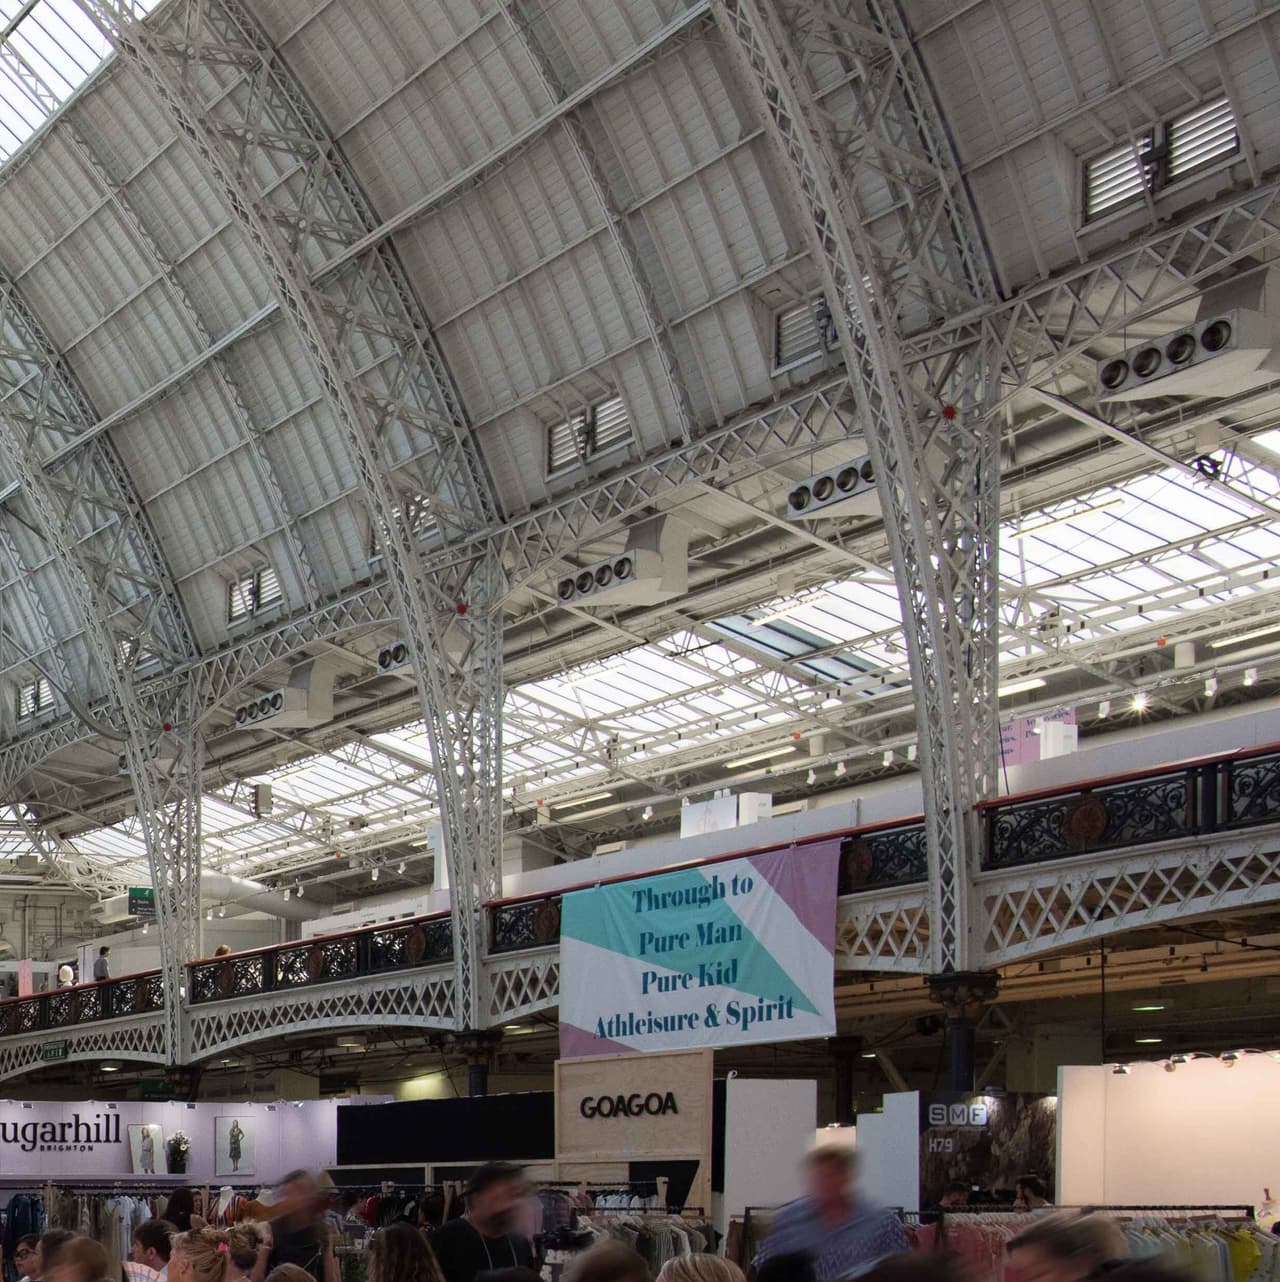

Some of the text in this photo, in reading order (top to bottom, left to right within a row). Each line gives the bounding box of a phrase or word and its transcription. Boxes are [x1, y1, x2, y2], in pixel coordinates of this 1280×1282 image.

[632, 873, 753, 914] Through to
[639, 922, 742, 955] Pure Man
[642, 958, 738, 994] Pure Kid
[594, 995, 794, 1039] Athleisure & Spirit
[580, 1092, 679, 1119] GOAGOA
[929, 1104, 987, 1125] SMF
[40, 1144, 94, 1153] BRIGHTON
[928, 1138, 953, 1152] H79
